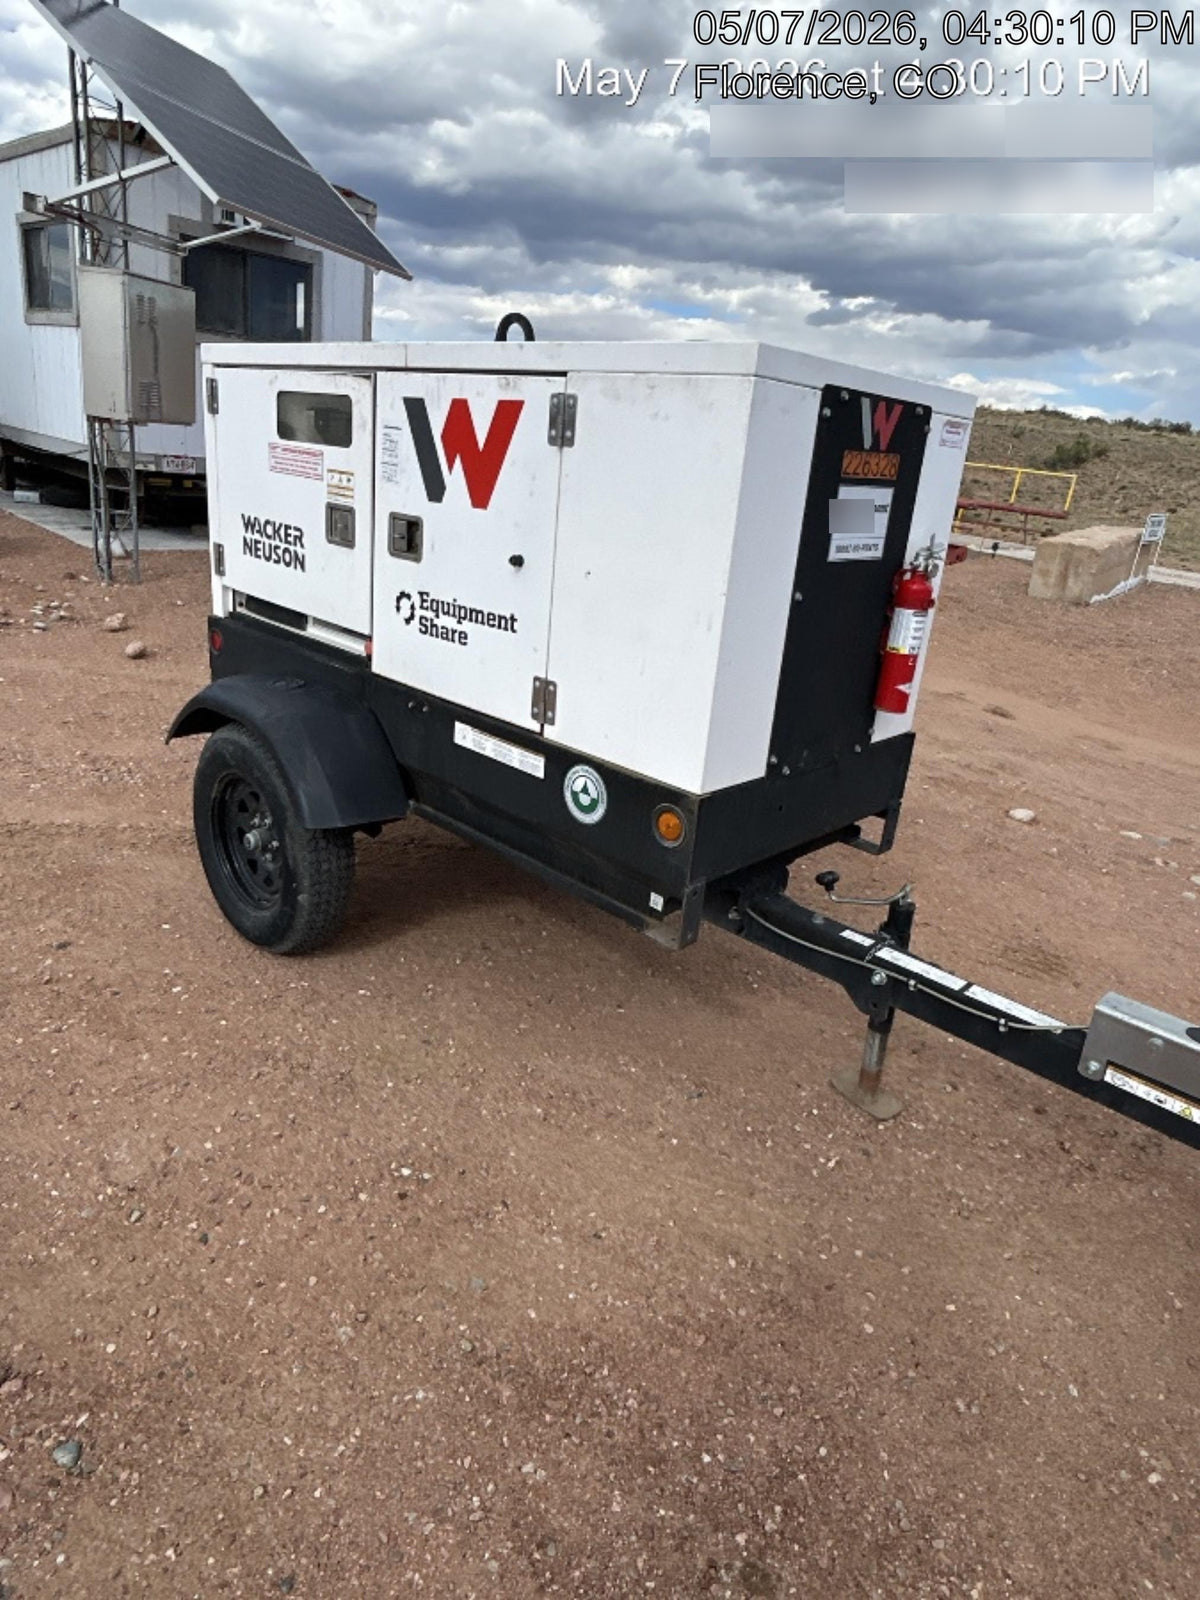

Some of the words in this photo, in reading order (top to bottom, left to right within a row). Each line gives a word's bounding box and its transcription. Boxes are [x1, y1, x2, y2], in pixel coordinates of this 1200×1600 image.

[241, 513, 304, 549] WACKER
[243, 535, 306, 573] NEUSON
[417, 591, 518, 634] Equipment
[418, 615, 469, 646] Share
